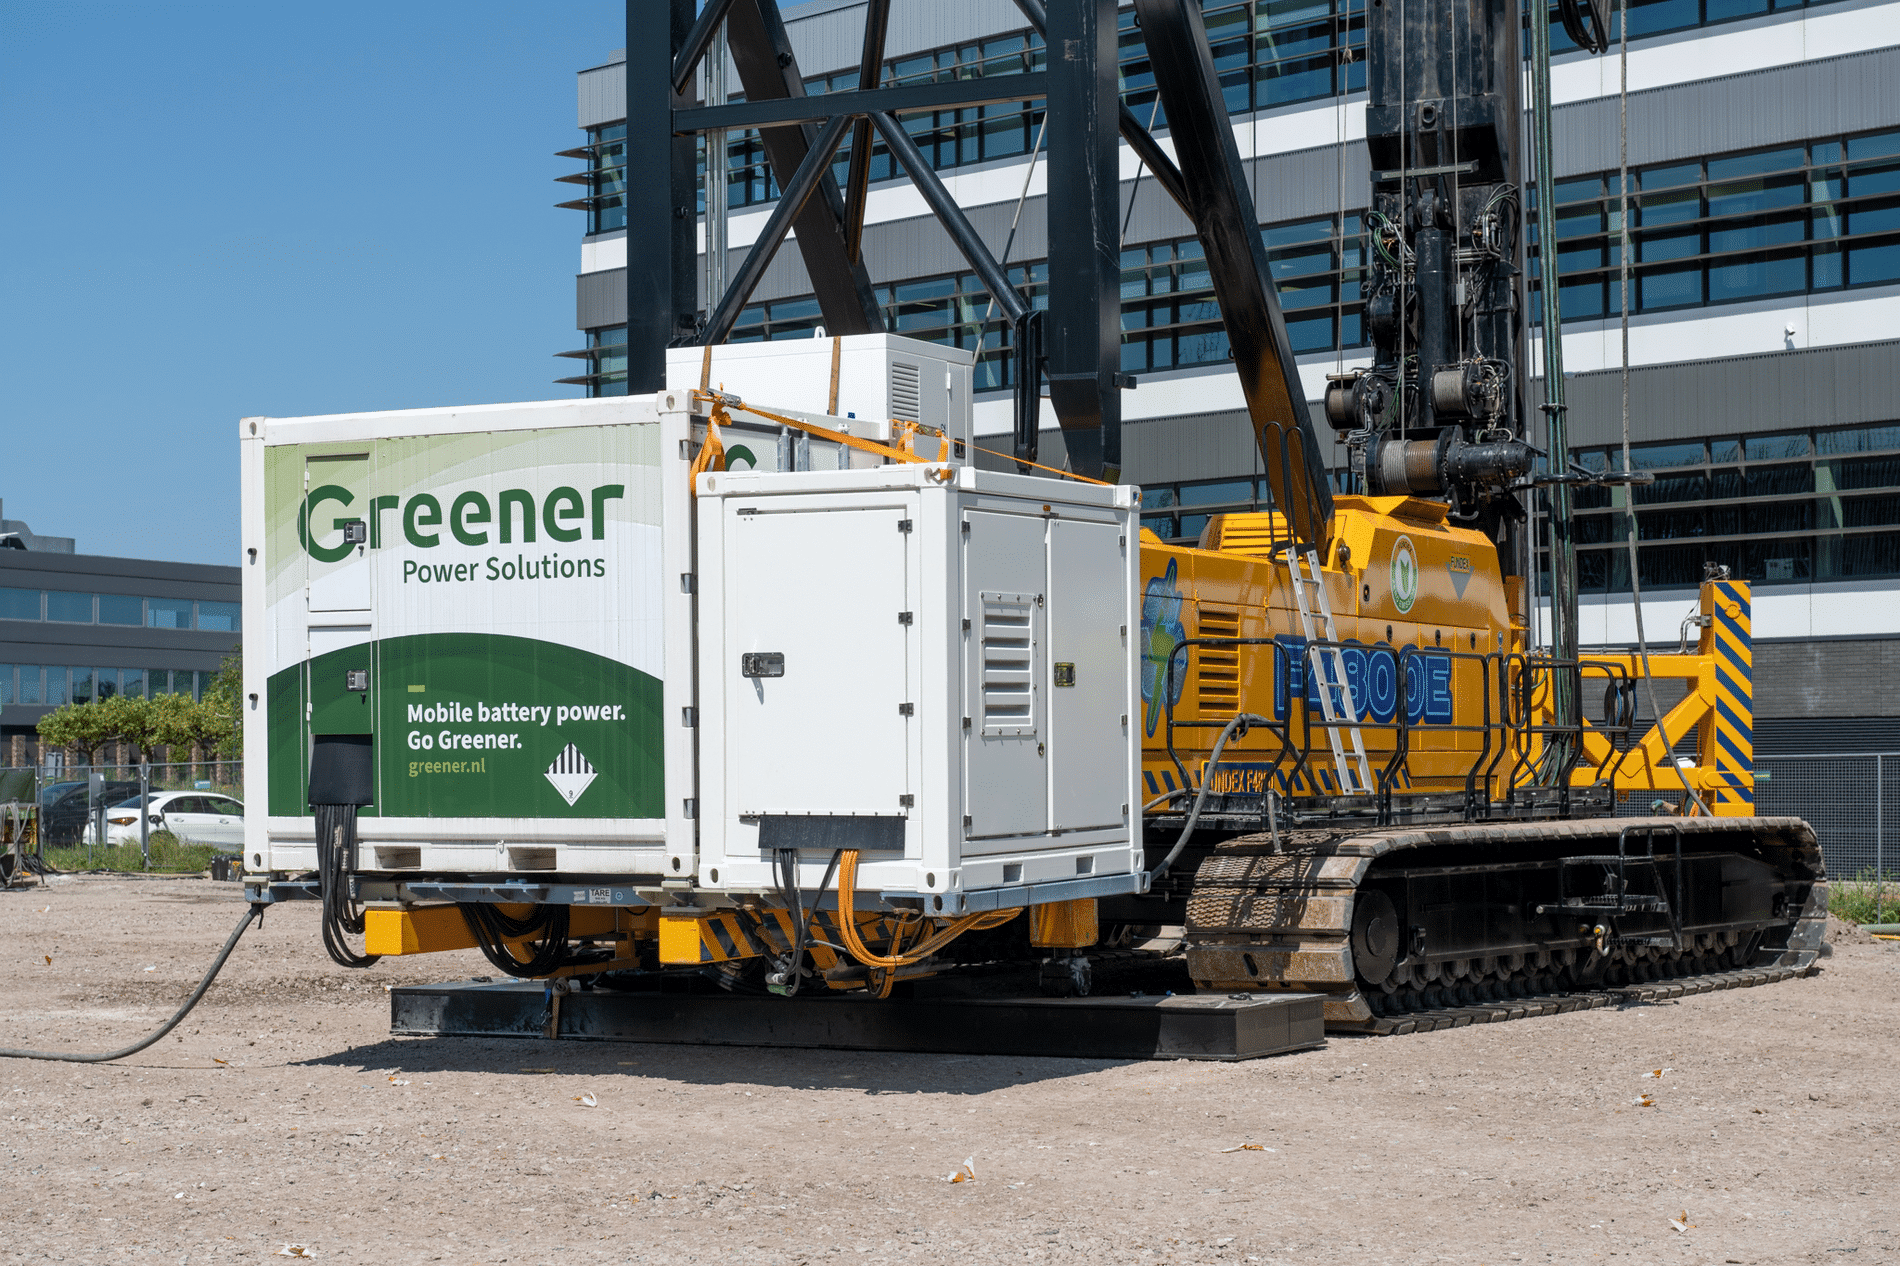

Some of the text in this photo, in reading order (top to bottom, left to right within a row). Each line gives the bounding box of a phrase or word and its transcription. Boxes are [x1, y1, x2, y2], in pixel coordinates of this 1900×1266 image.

[297, 484, 625, 563] Greener
[403, 552, 605, 583] Power Solutions
[407, 702, 626, 726] Mobile battery power.
[407, 730, 522, 750] Go Greener.
[408, 757, 486, 777] greener.nl
[590, 889, 610, 897] TARE
